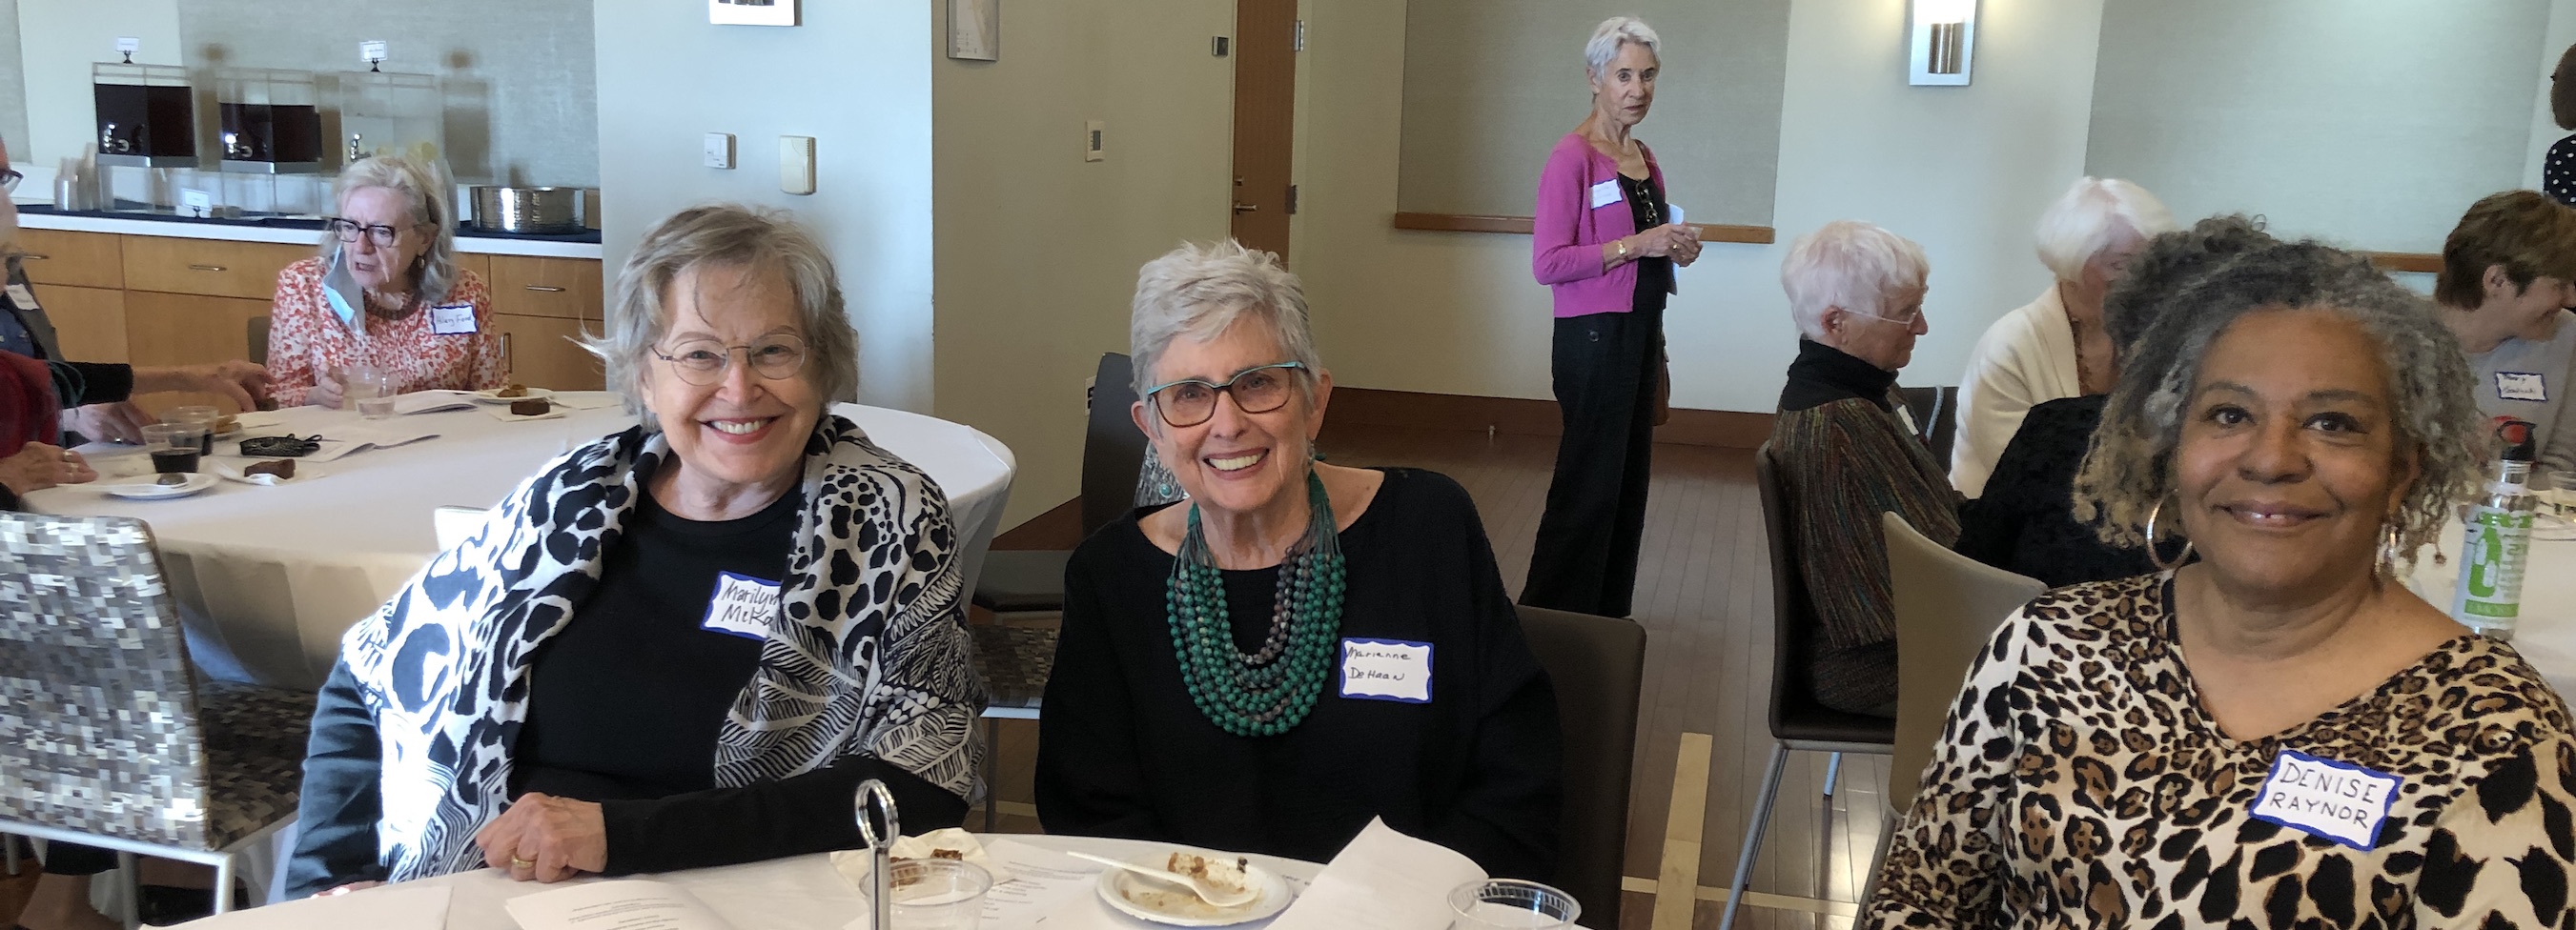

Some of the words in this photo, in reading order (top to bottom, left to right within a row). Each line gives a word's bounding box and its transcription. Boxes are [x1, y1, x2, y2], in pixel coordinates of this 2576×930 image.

[721, 580, 780, 613] Marilyn
[2280, 761, 2378, 804] DENISE
[2269, 792, 2368, 829] RAYNOR
